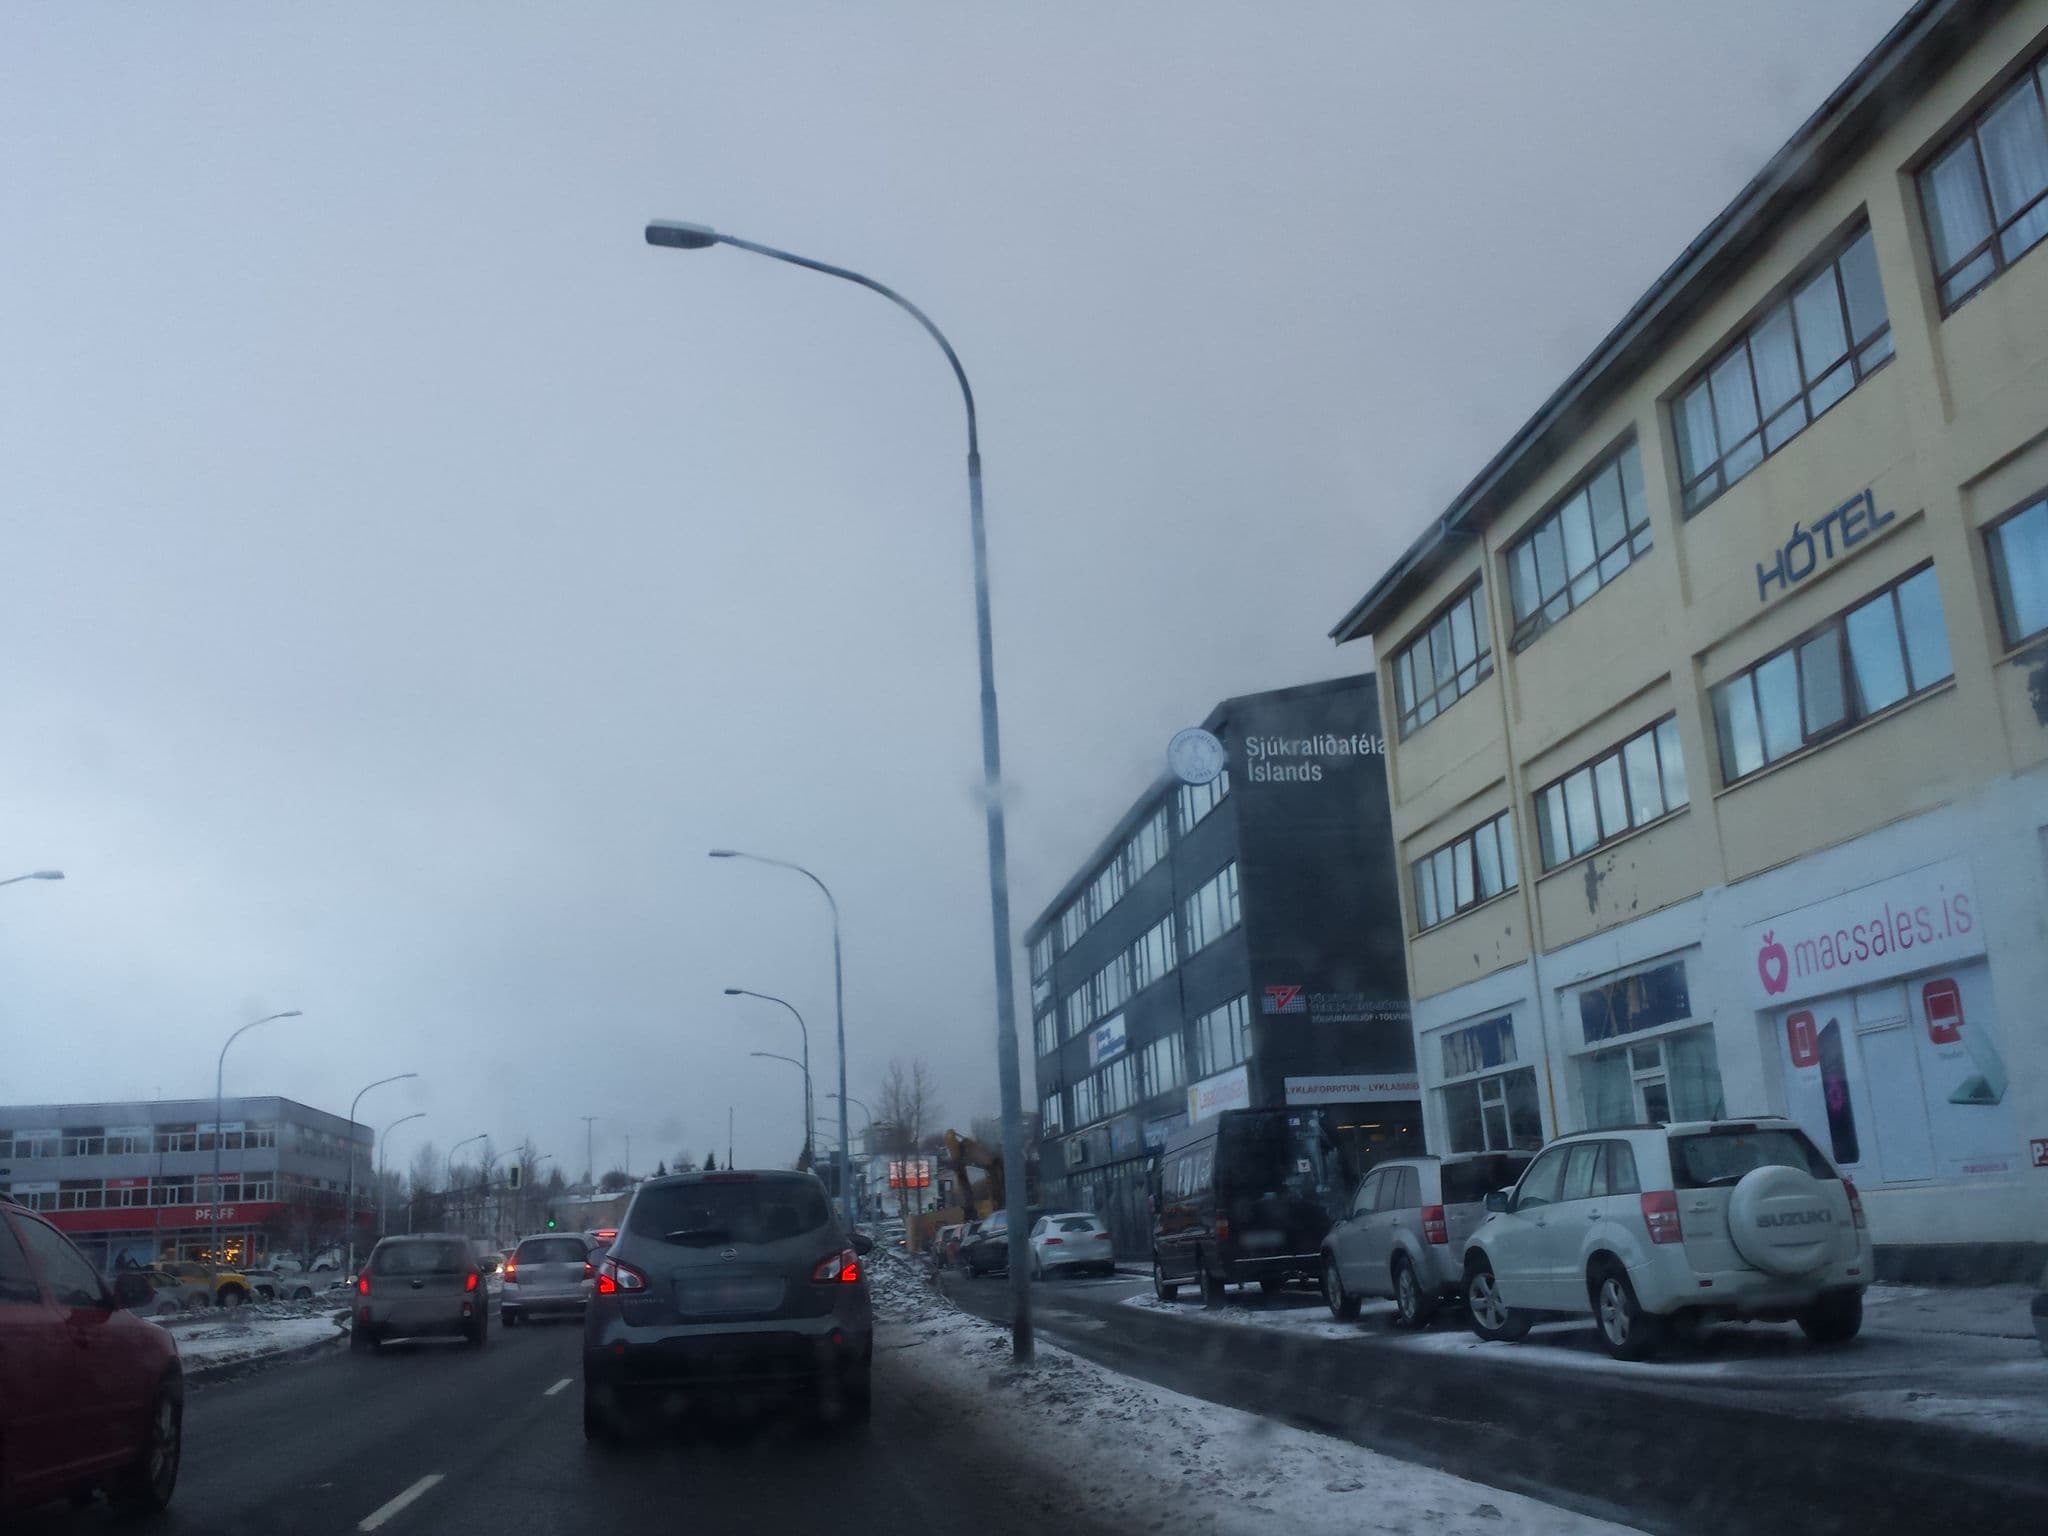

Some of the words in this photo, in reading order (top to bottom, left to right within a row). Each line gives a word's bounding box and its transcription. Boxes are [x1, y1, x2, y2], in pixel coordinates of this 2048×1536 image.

[1755, 488, 1896, 602] HÓTEL
[1249, 757, 1322, 781] Íslands
[1795, 884, 1974, 978] macsales.is
[194, 1207, 236, 1222] PFAFF
[1756, 1209, 1832, 1228] SUZUKI
